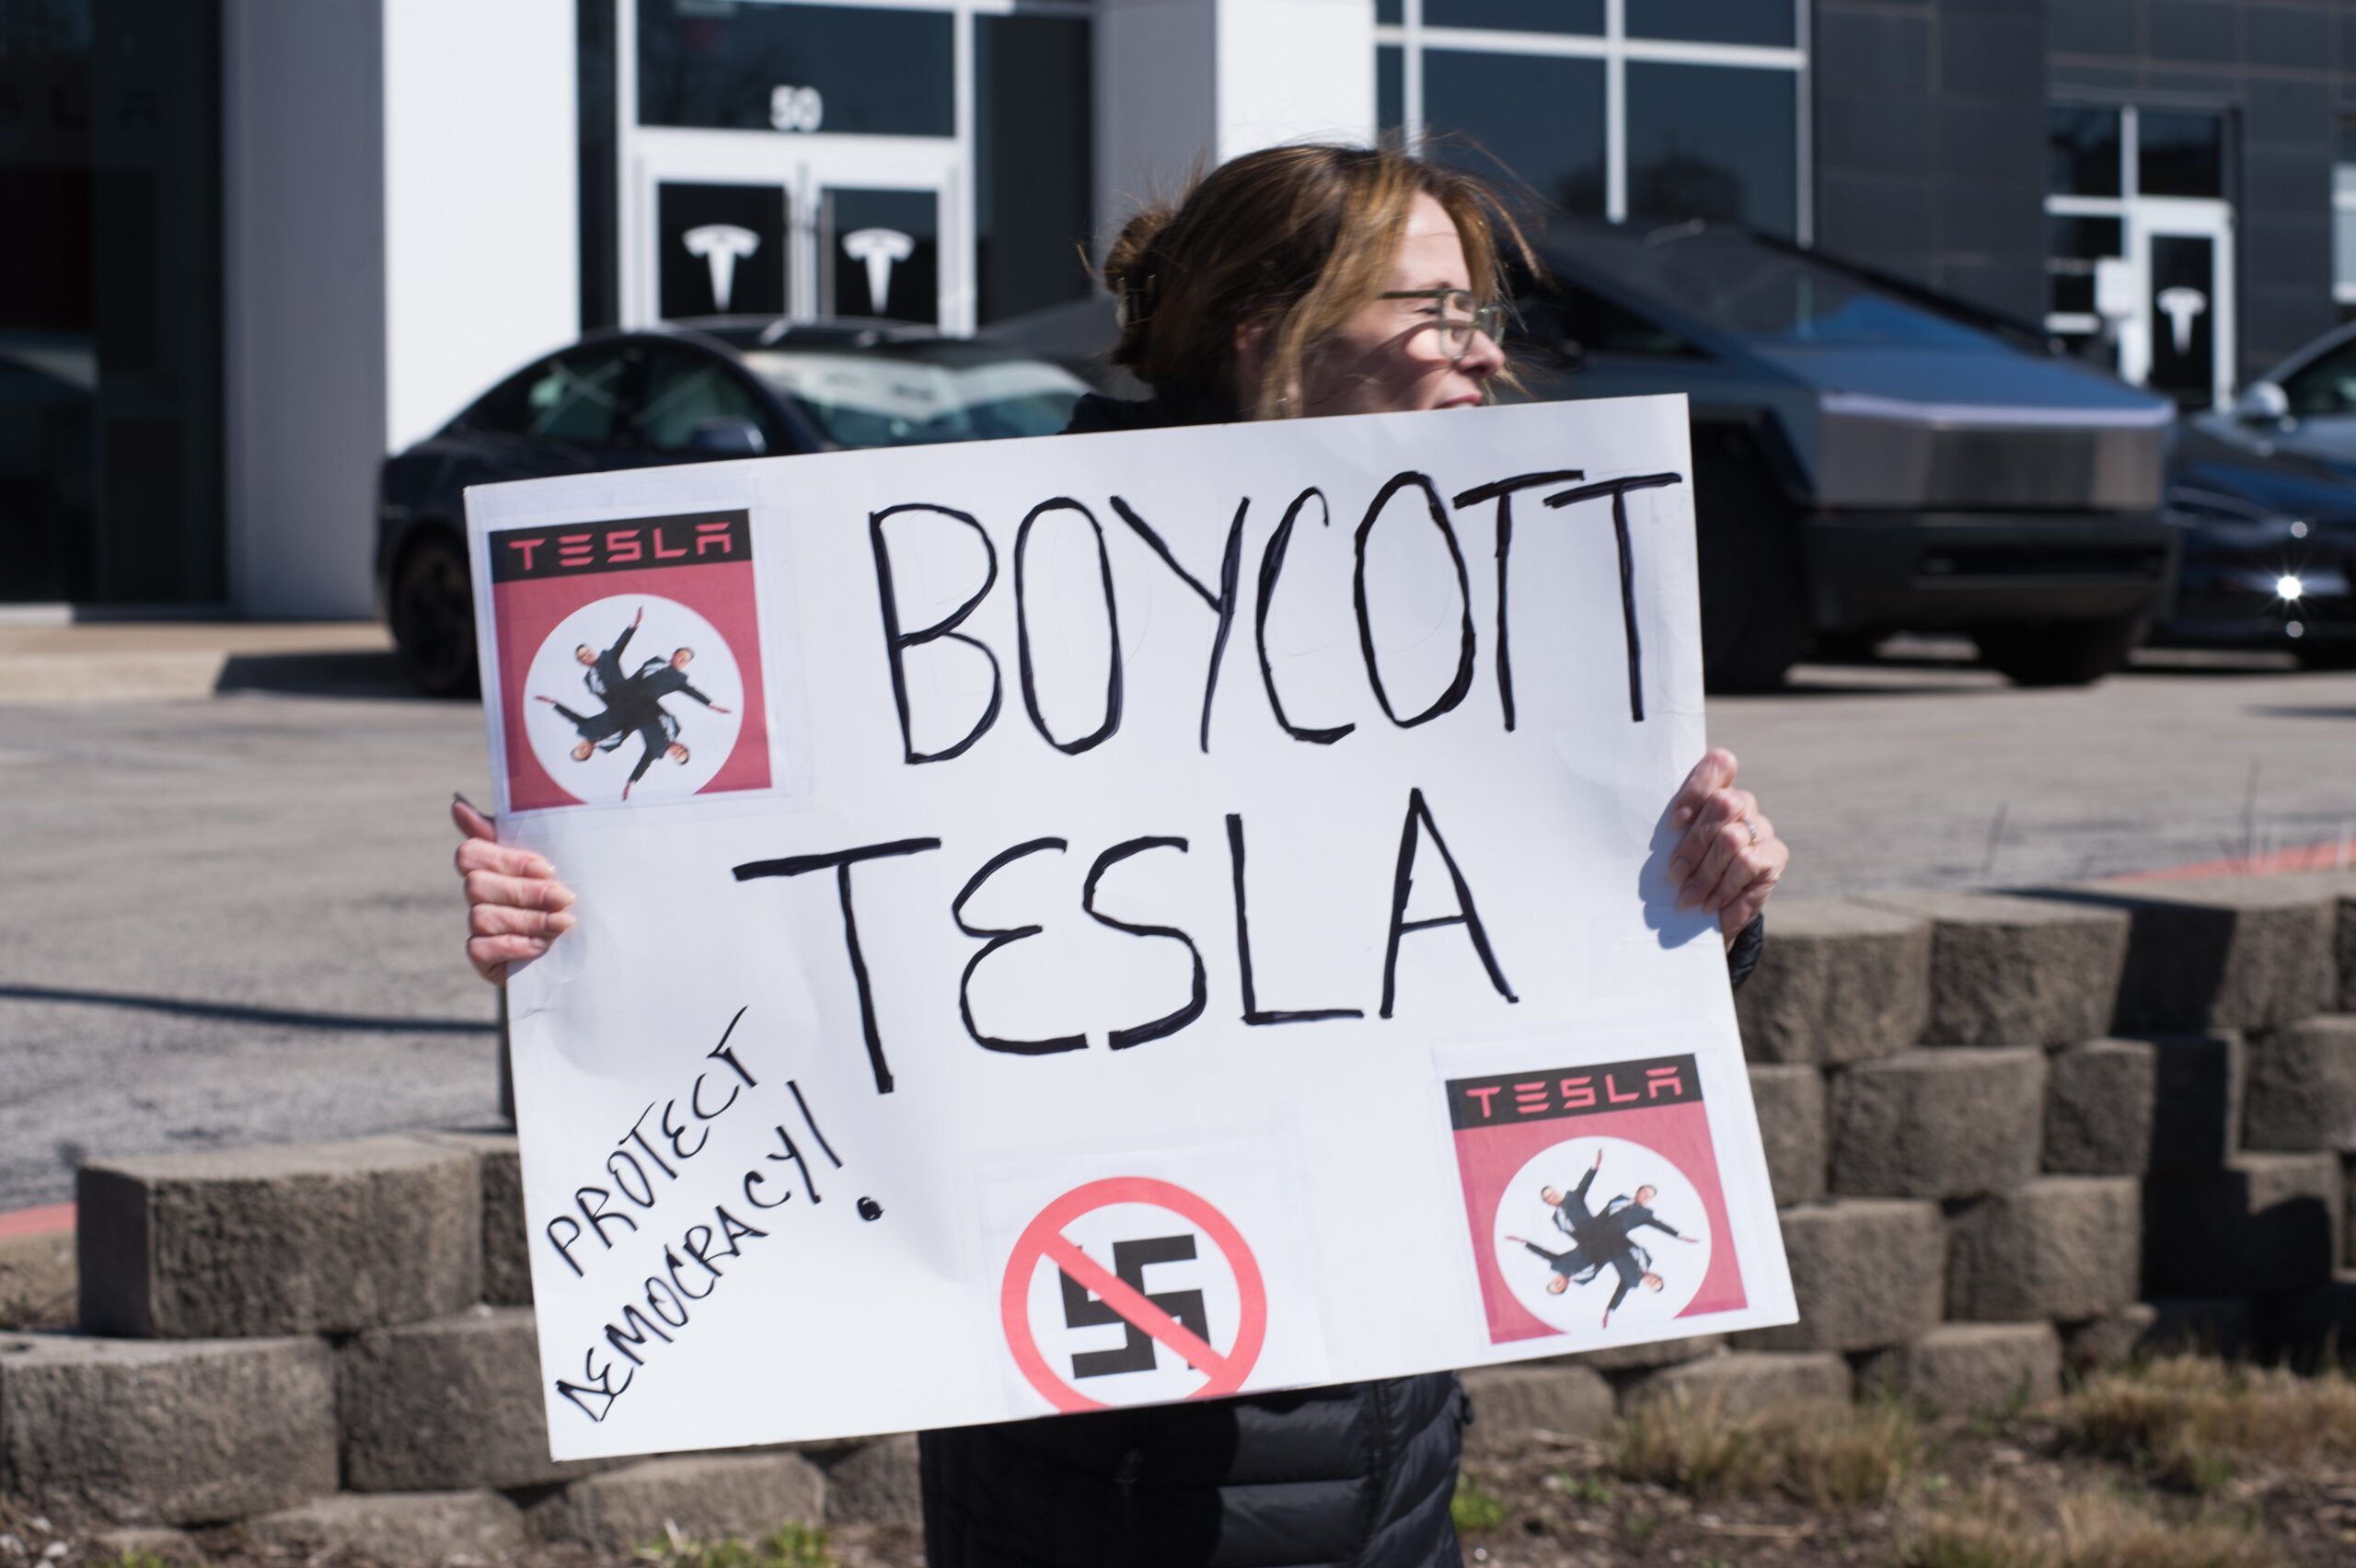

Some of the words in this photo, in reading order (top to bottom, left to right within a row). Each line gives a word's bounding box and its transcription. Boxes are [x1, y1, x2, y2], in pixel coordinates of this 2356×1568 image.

[770, 84, 823, 132] 50
[508, 521, 733, 571] TESLA
[869, 470, 1682, 765] BOYCOTT
[732, 788, 1519, 1094] TESLA
[546, 1004, 758, 1277] PROTECT
[1465, 1066, 1683, 1119] TESLA
[555, 1079, 884, 1423] DEMOCRACY!
